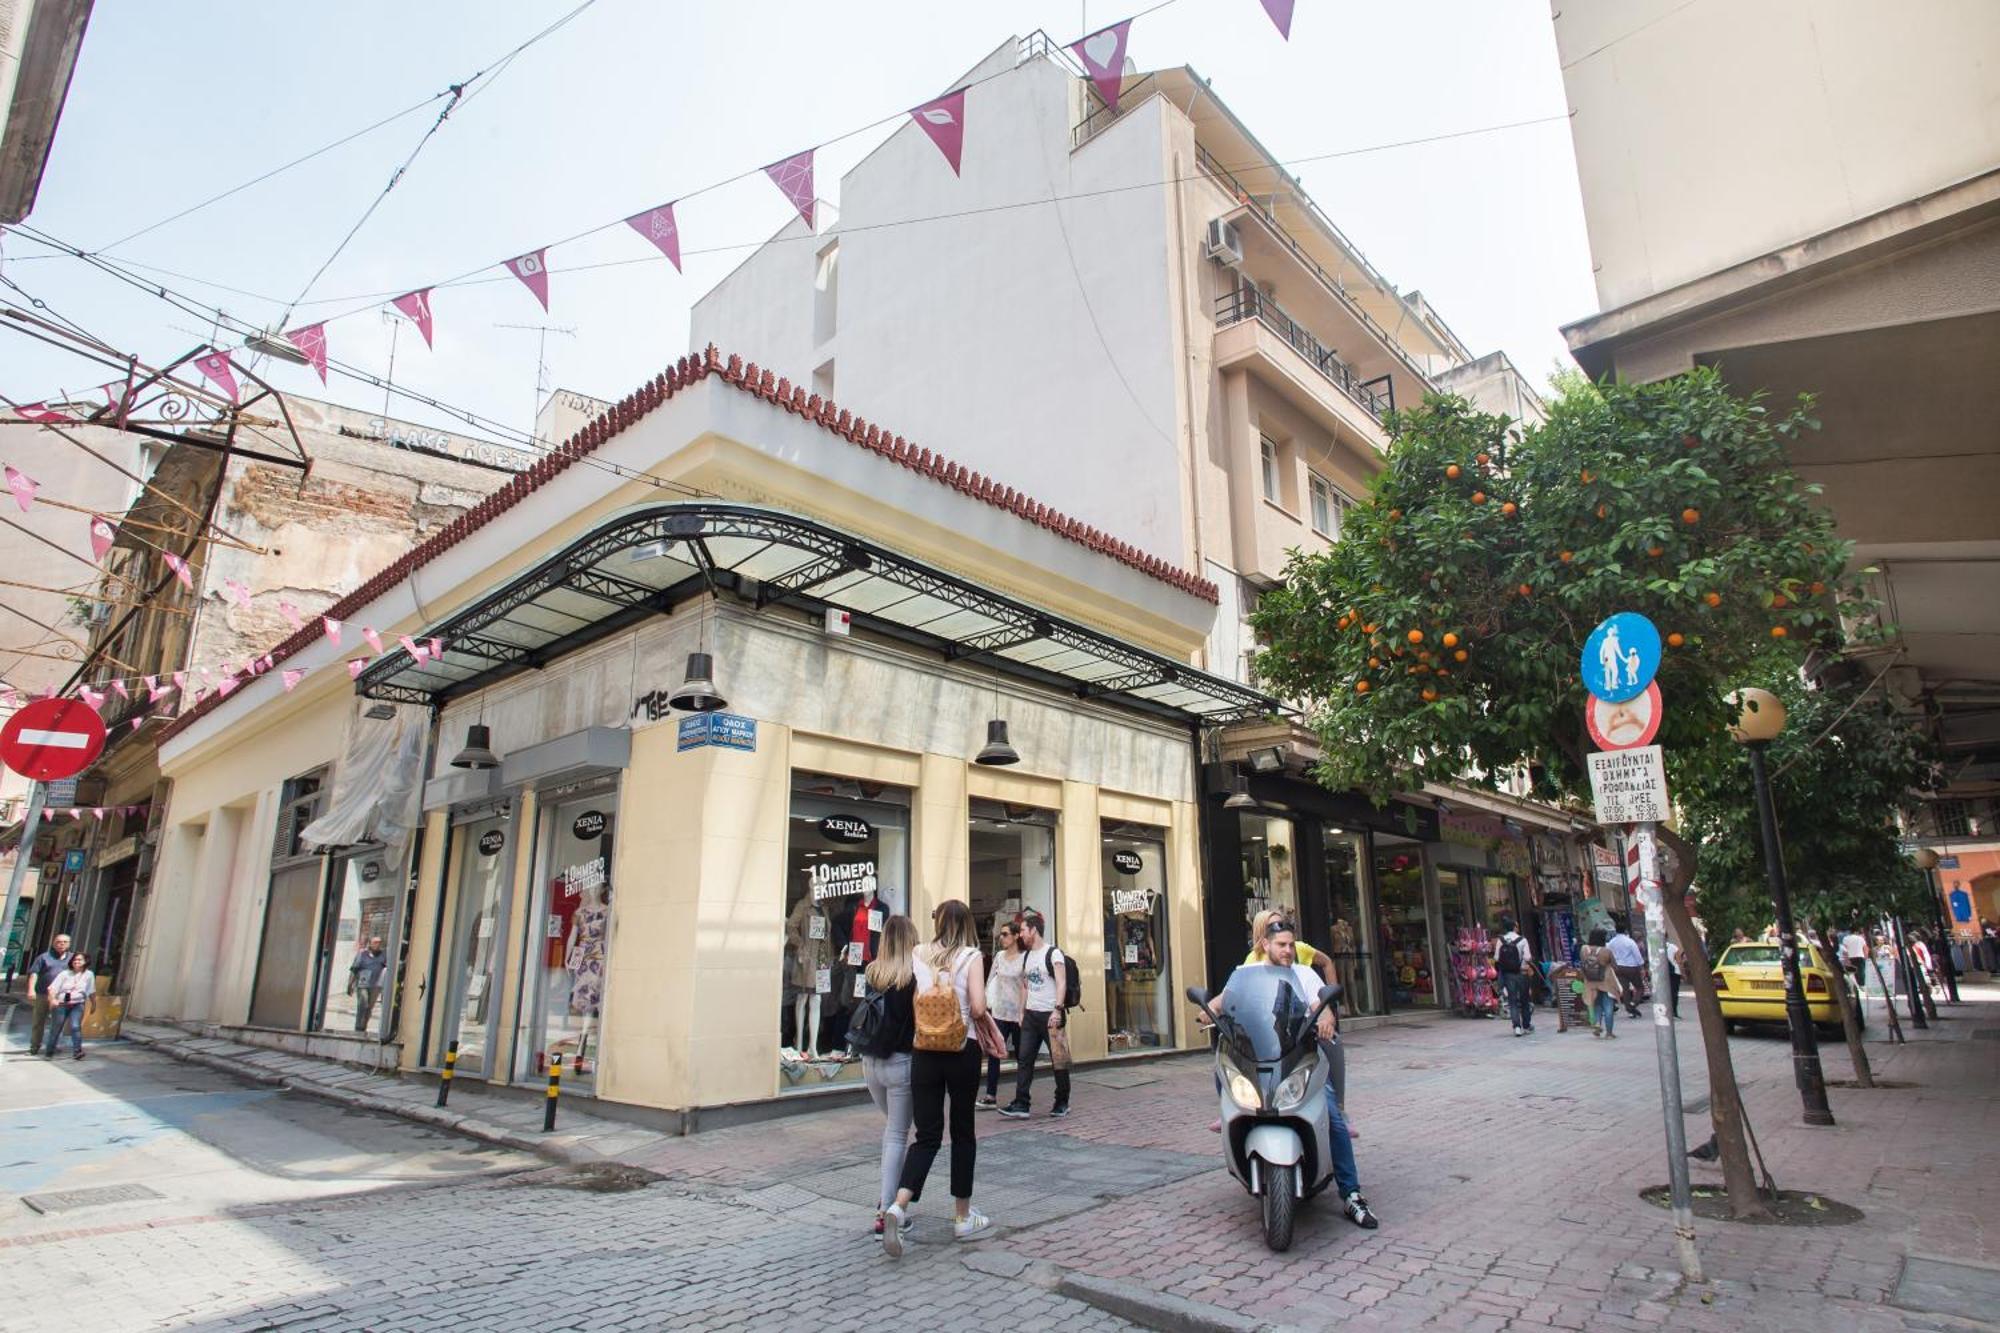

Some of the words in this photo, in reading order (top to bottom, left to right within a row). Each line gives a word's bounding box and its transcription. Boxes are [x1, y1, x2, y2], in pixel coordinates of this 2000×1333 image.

[575, 815, 603, 829] XENIA
[825, 819, 868, 833] XENIA
[1115, 854, 1141, 865] XENIA
